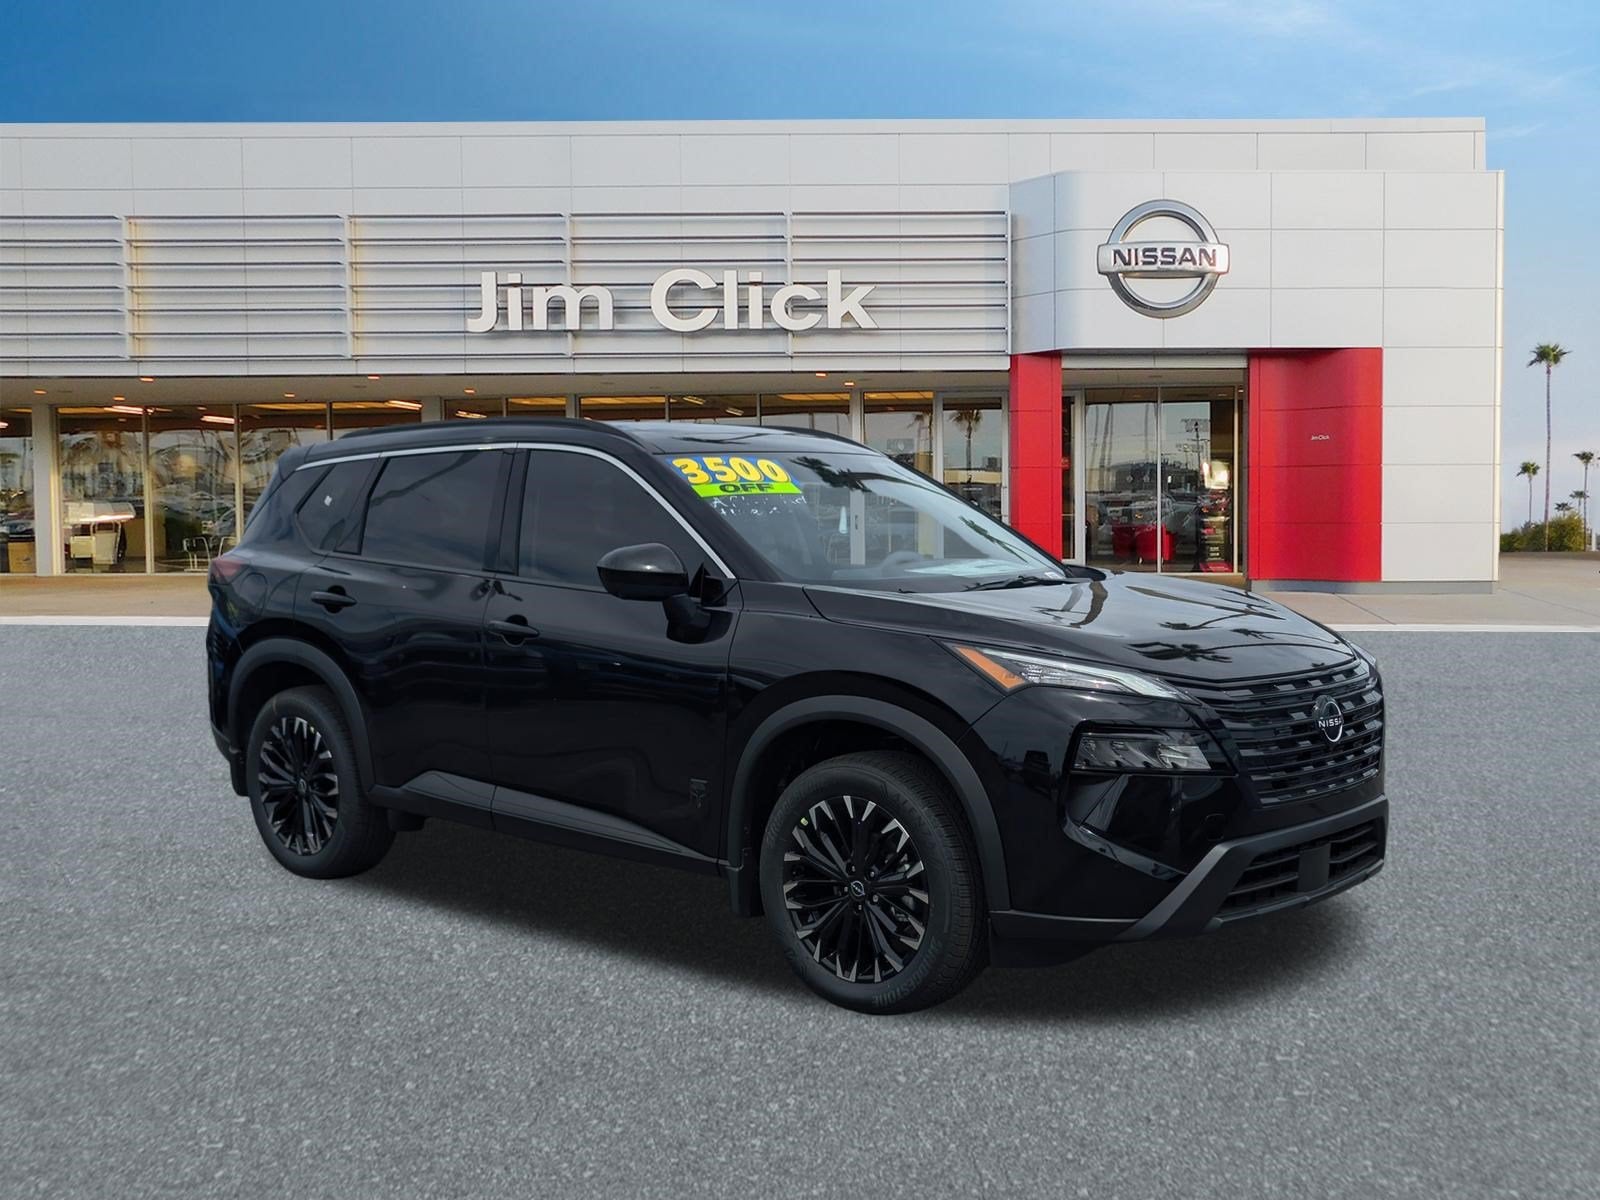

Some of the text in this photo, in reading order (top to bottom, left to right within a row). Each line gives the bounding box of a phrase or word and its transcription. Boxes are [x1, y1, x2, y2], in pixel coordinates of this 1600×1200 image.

[1112, 247, 1217, 267] NISSAN
[466, 268, 879, 333] Jim Click
[672, 457, 791, 484] 3500
[719, 483, 775, 493] OFF
